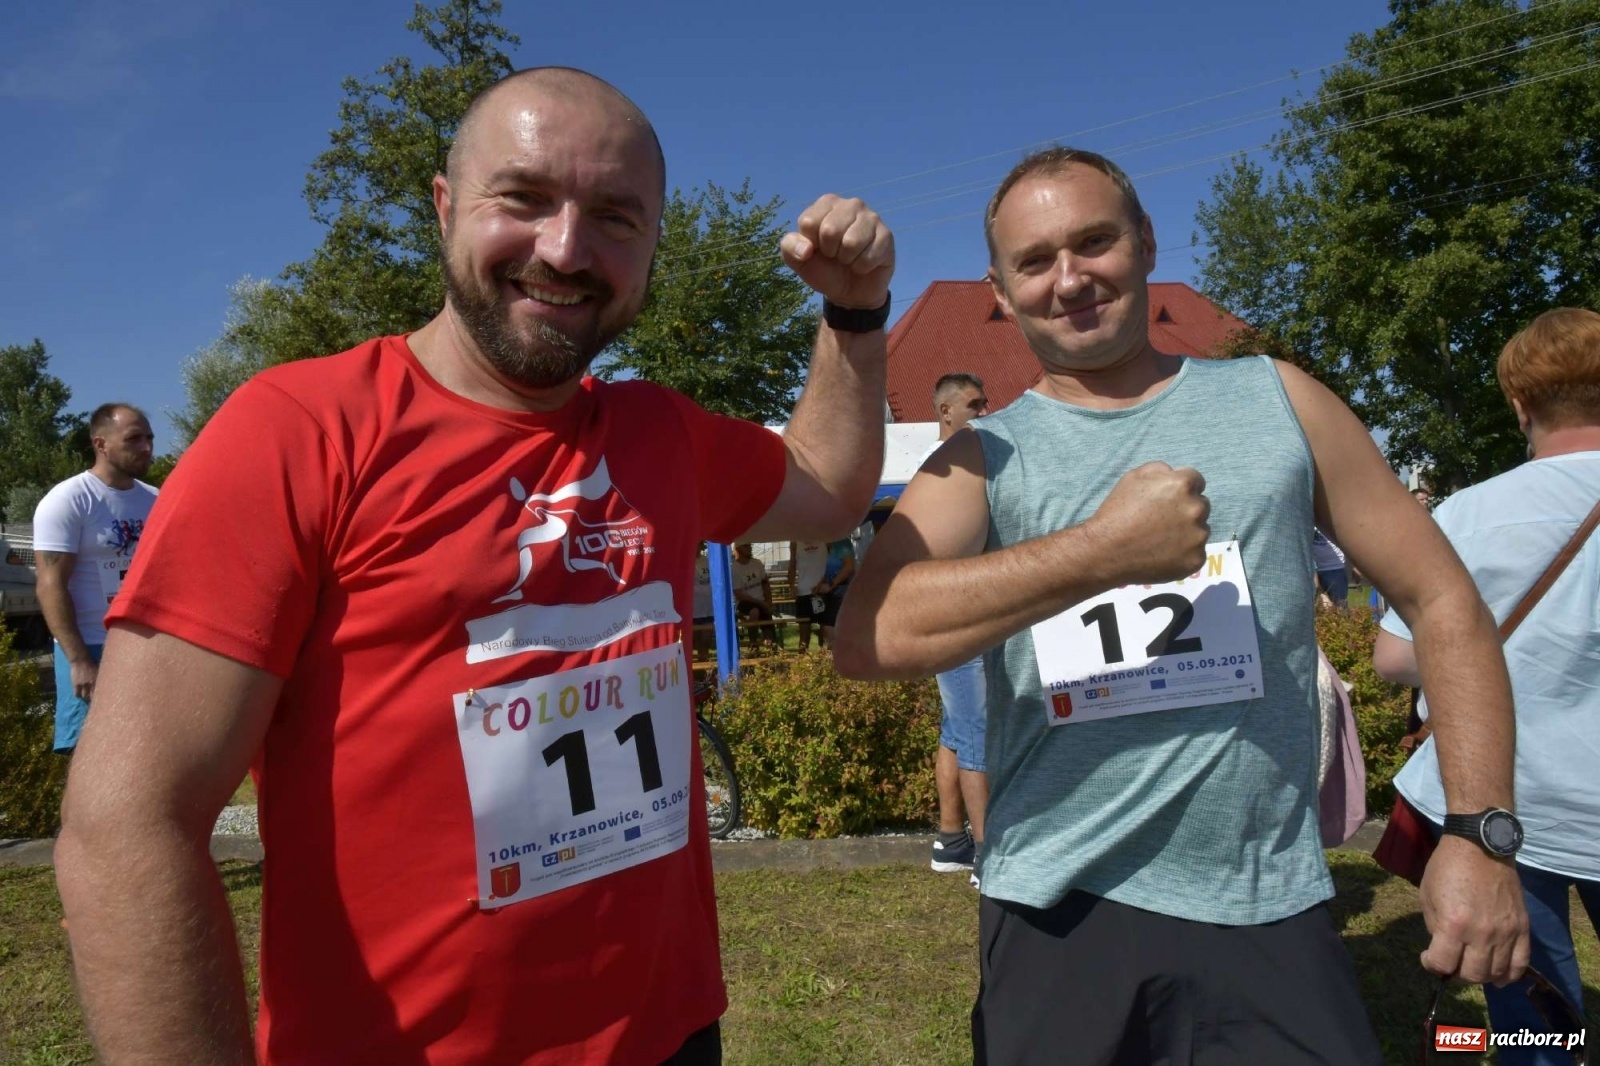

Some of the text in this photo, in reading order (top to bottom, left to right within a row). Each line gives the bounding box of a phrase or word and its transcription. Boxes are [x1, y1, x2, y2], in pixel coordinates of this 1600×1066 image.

[481, 637, 540, 653] Narodowy
[1080, 592, 1203, 665] 12
[482, 658, 680, 736] COLOUR RUN
[1049, 678, 1085, 692] 10km,
[1088, 666, 1169, 686] Krzanowice,
[1177, 653, 1253, 672] 05.09.2021
[541, 710, 663, 816] 11
[488, 842, 543, 864] 10km,
[549, 808, 645, 846] Krzanowice,
